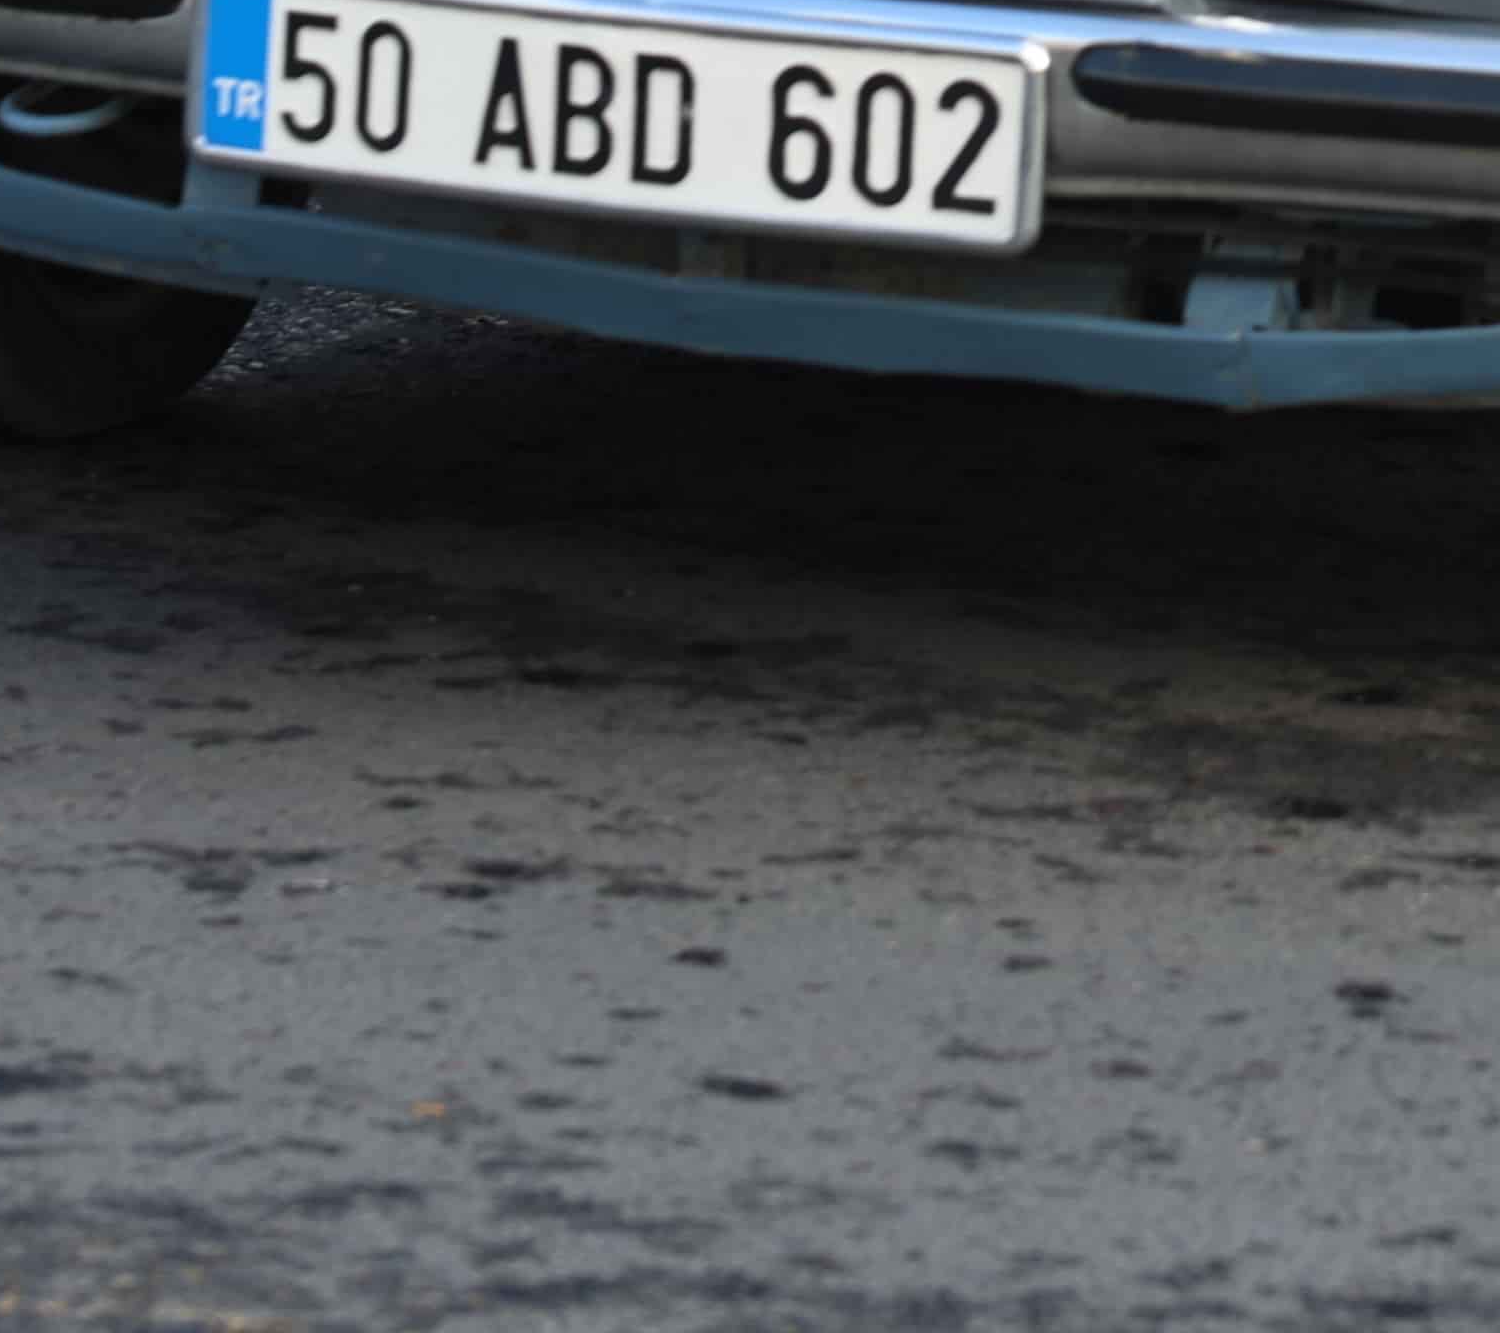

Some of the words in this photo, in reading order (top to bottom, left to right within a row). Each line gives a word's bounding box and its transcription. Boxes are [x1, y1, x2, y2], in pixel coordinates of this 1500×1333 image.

[212, 77, 263, 121] TR
[280, 10, 412, 153] 50
[474, 37, 698, 186] ABD
[768, 64, 1003, 216] 602
